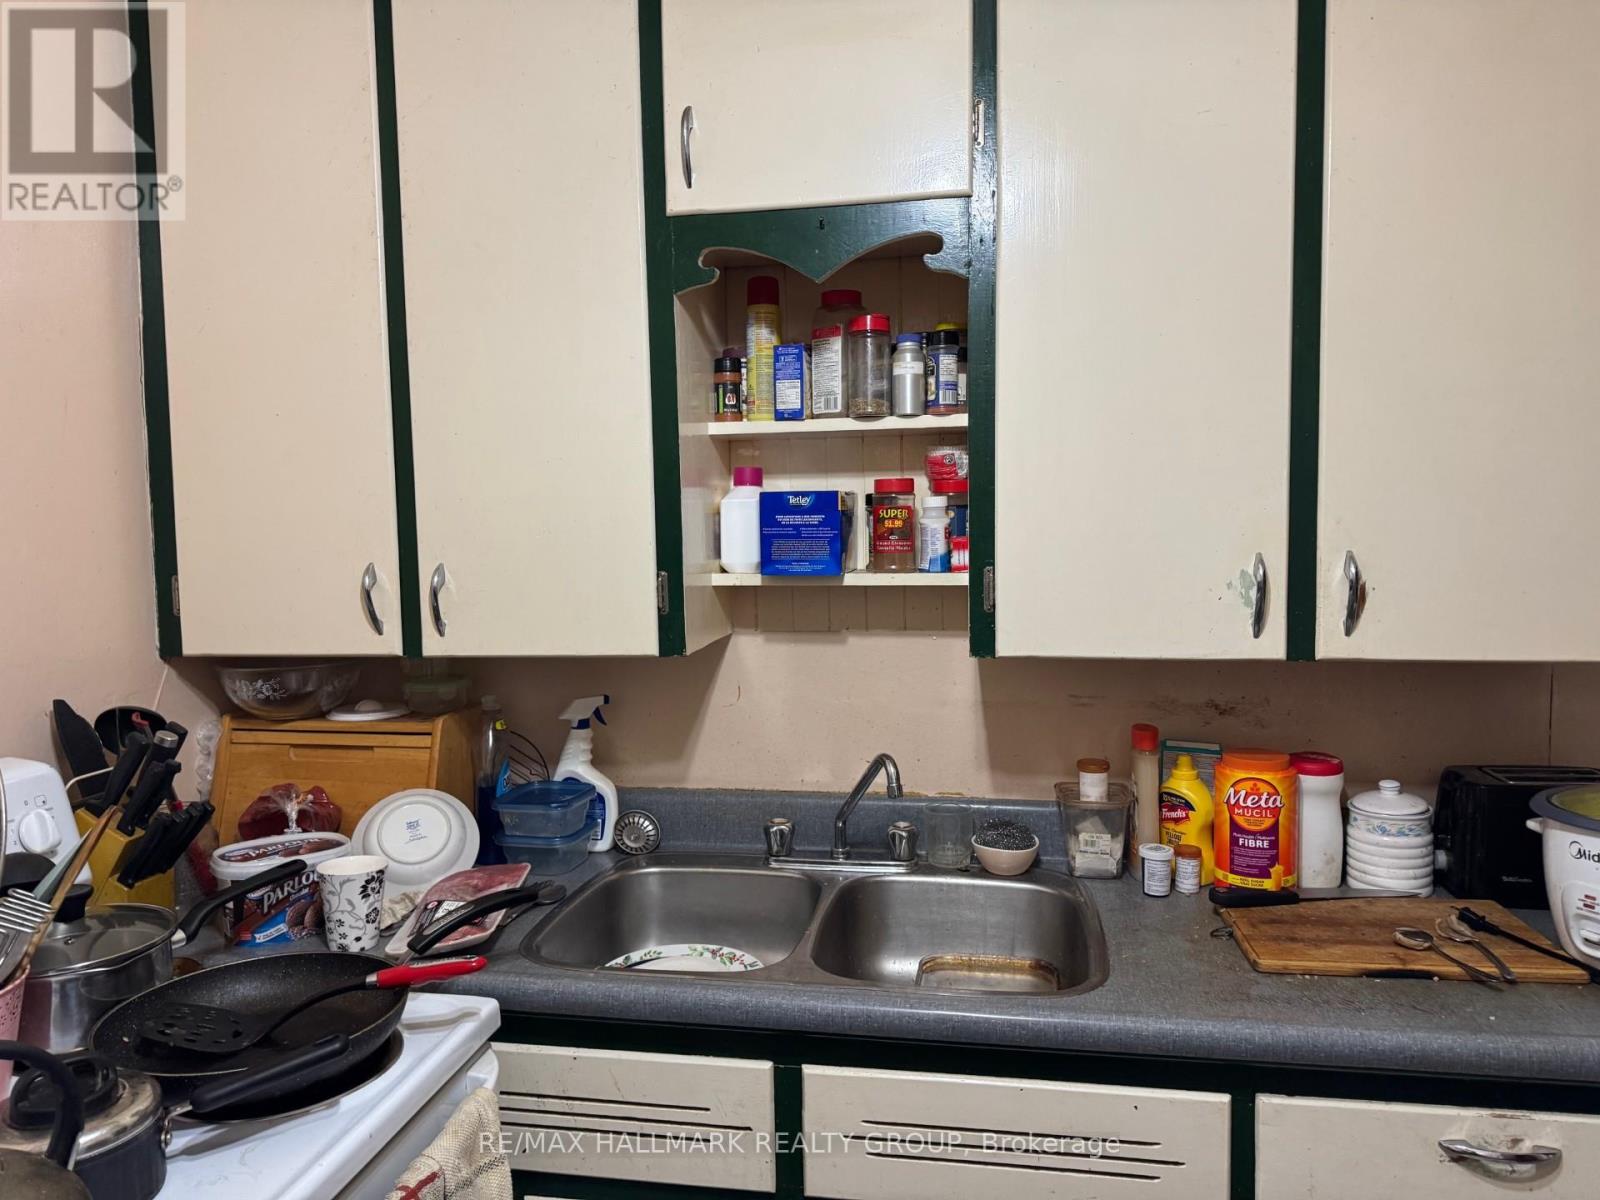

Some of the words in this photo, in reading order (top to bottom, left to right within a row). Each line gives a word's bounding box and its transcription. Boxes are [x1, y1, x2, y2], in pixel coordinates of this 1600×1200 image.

[787, 495, 811, 506] Tetley
[879, 509, 909, 518] SUPER
[1224, 787, 1284, 808] Meta
[1162, 808, 1187, 819] French's
[1234, 808, 1273, 818] MUCIL
[1239, 838, 1270, 848] FIBRE
